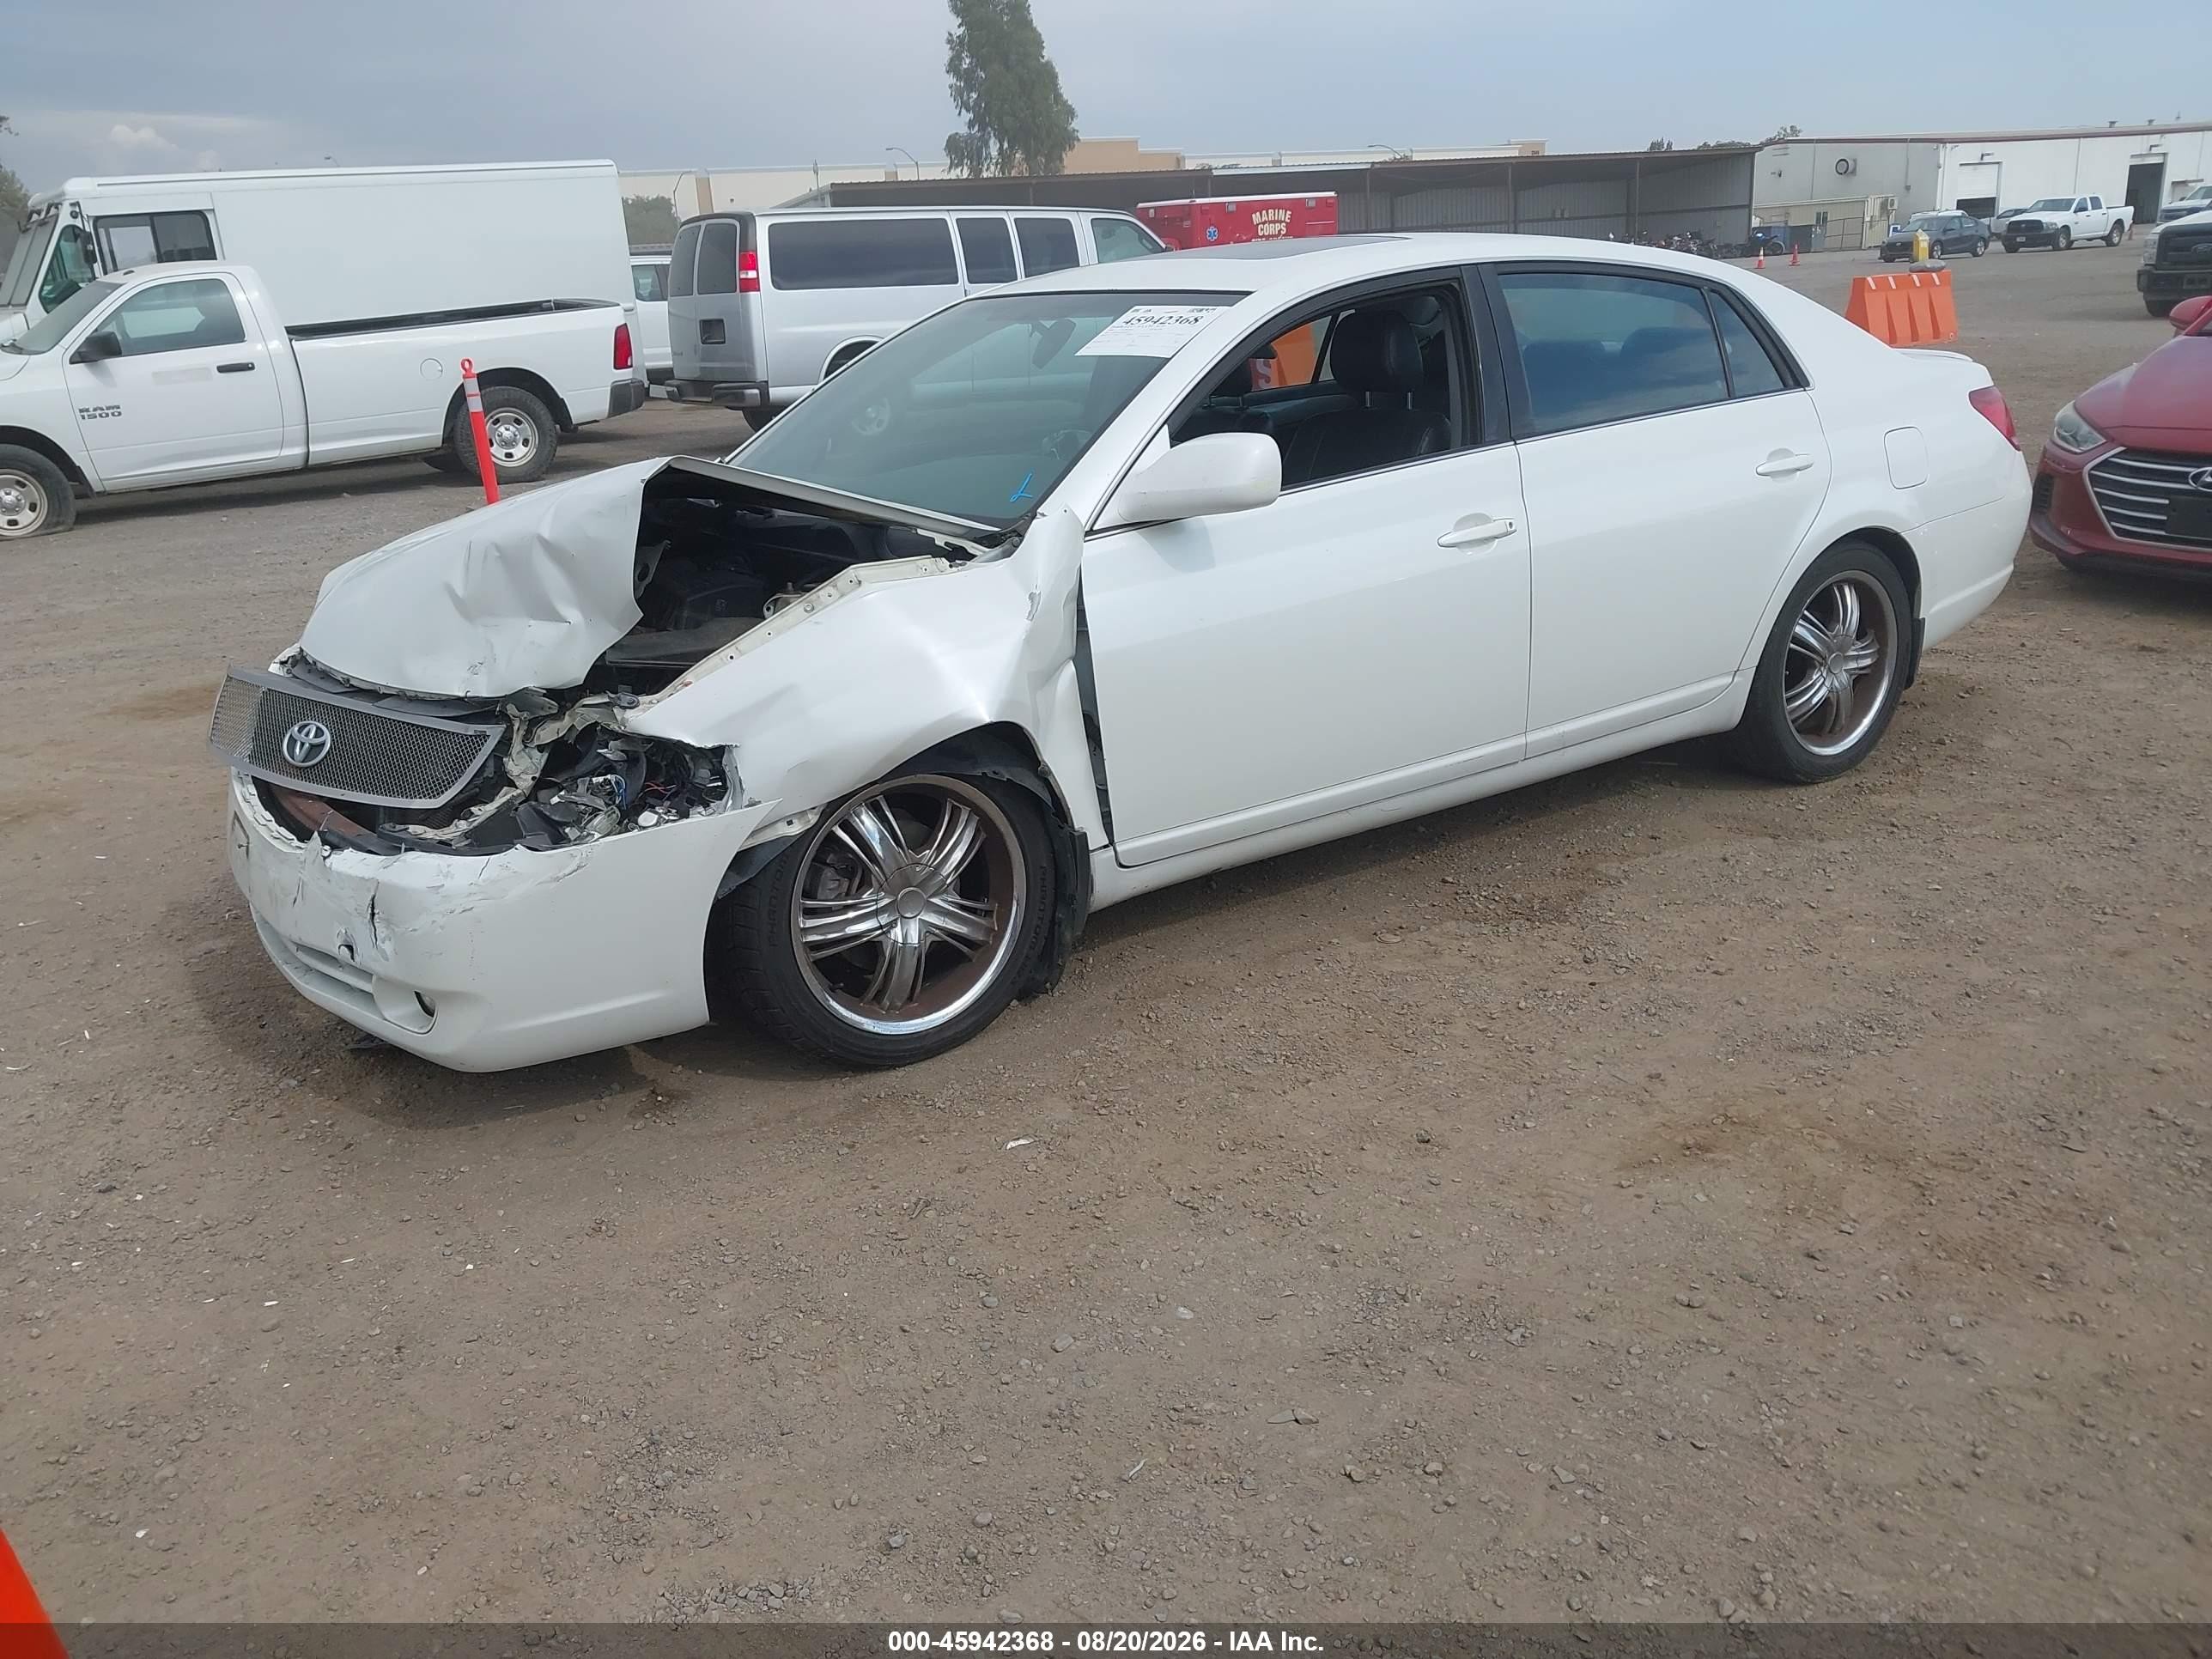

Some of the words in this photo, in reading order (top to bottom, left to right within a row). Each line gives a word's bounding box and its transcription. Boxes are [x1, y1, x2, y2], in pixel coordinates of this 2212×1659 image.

[1252, 209, 1291, 225] MARINE
[1258, 222, 1286, 236] CORPS
[1122, 315, 1204, 325] 45942368
[78, 404, 120, 413] RAM
[80, 411, 122, 420] 1500
